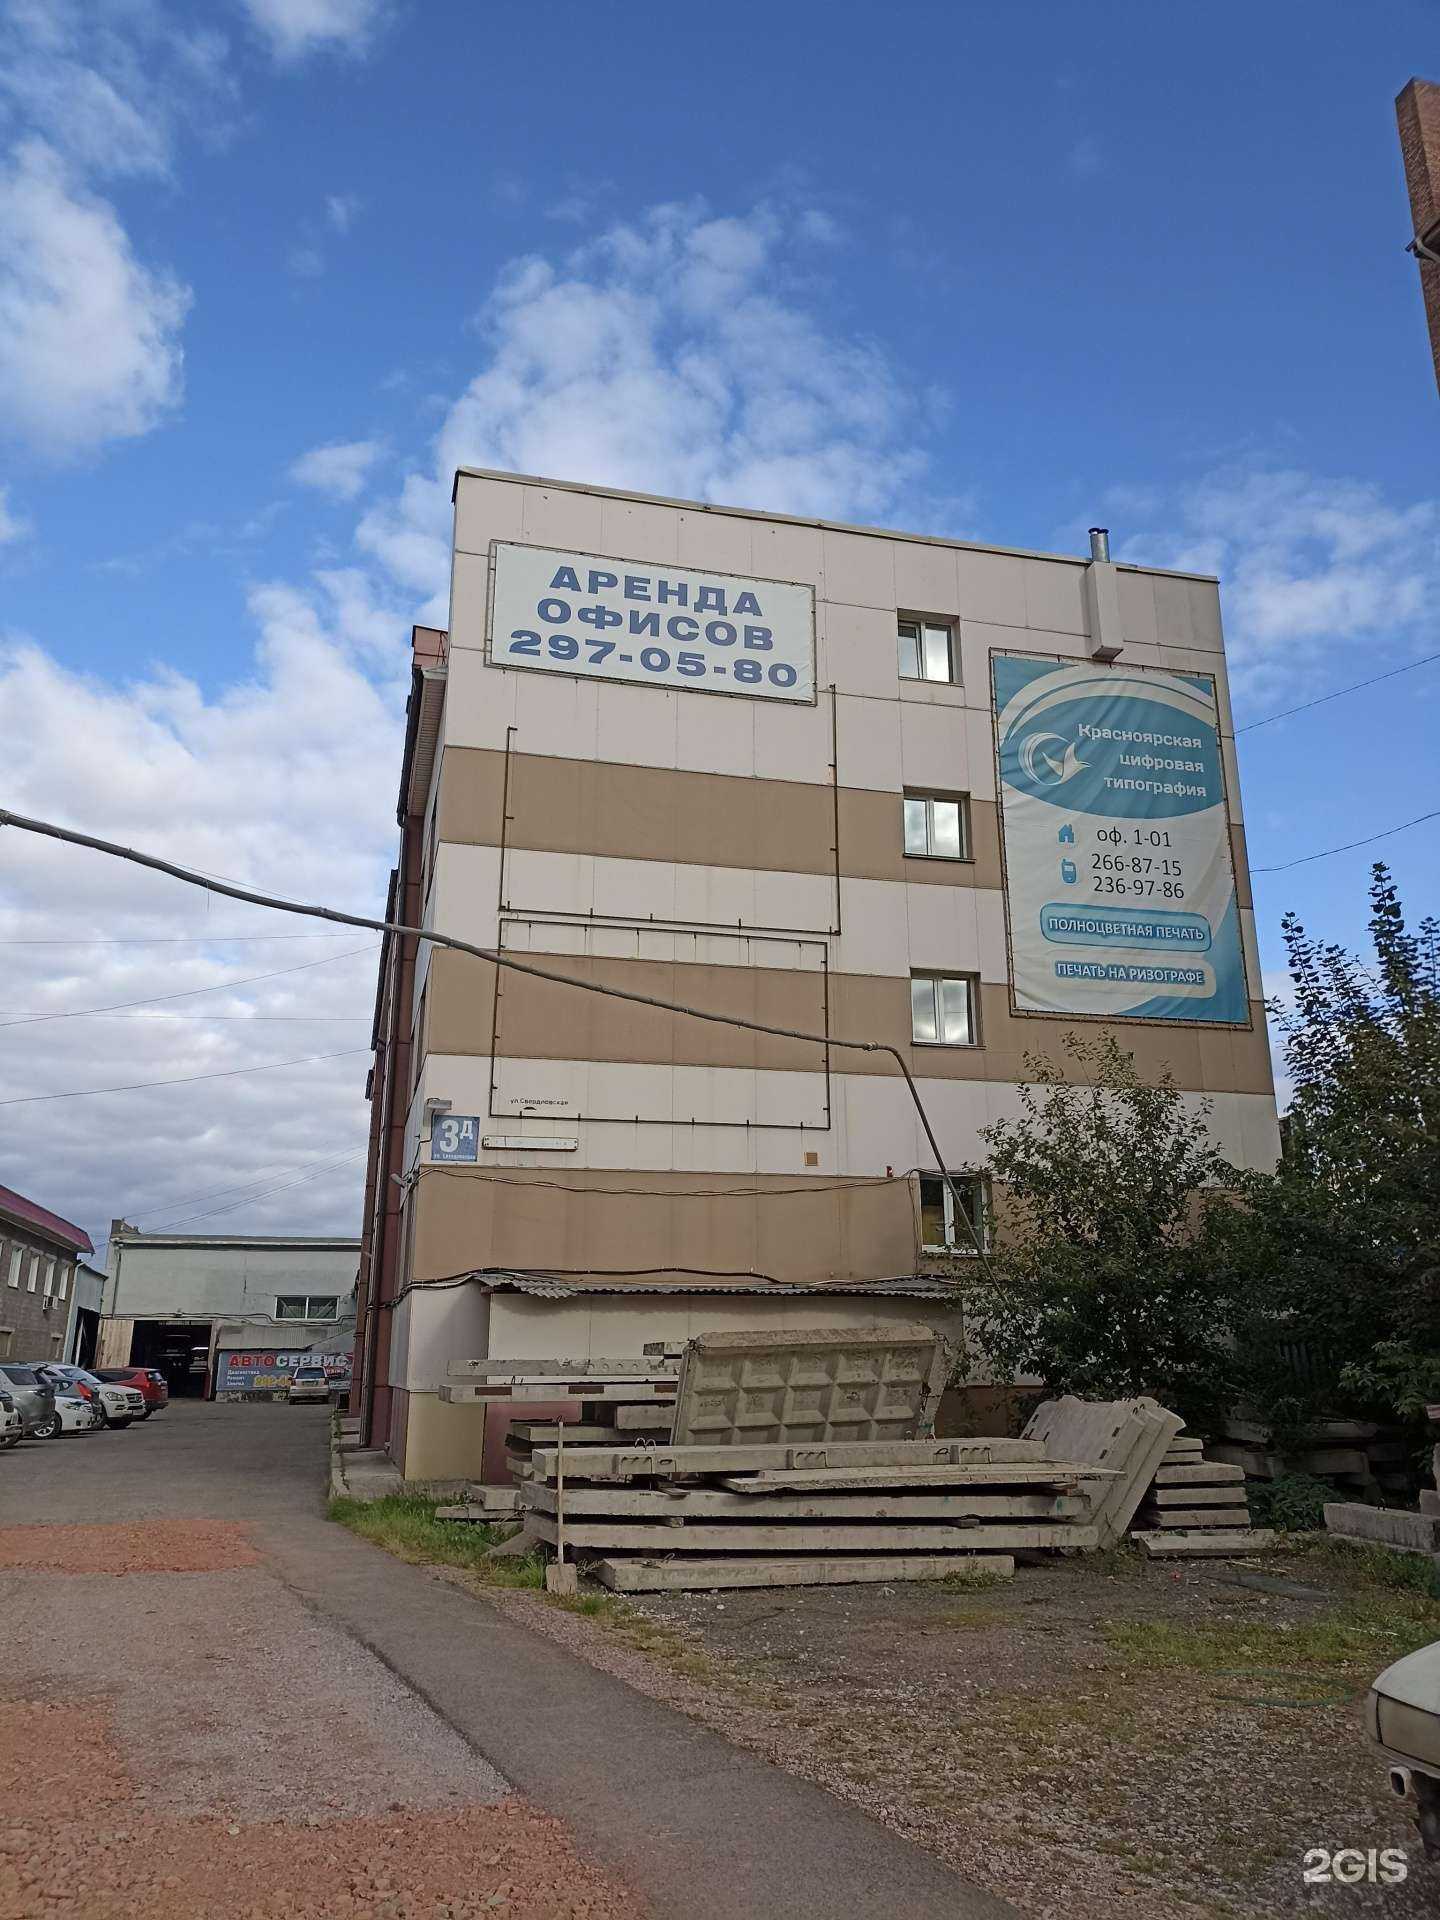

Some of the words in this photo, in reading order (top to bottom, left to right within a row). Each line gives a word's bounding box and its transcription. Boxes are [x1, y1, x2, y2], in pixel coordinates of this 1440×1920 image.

[549, 565, 763, 617] АРЕНДА
[537, 598, 774, 651] ОФИСОВ
[508, 629, 798, 688] 297-05-80
[1077, 723, 1202, 749] Красноярская
[1119, 753, 1204, 773] цифровая
[1103, 776, 1207, 797] типография
[1097, 826, 1127, 846] оф.
[1134, 829, 1172, 847] 1-01
[1091, 853, 1182, 876] 266-87-15
[1093, 876, 1185, 899] 236-97-86
[1049, 917, 1152, 938] ПОЛНОЦВЕТНАЯ
[1156, 926, 1204, 941] ПЕЧАТЬ
[1056, 962, 1106, 977] ПЕЧАТЬ
[1109, 967, 1127, 979] НА
[1130, 968, 1204, 983] РИЗОГРАФЕ
[229, 1354, 348, 1367] АВТОСЕРВИС
